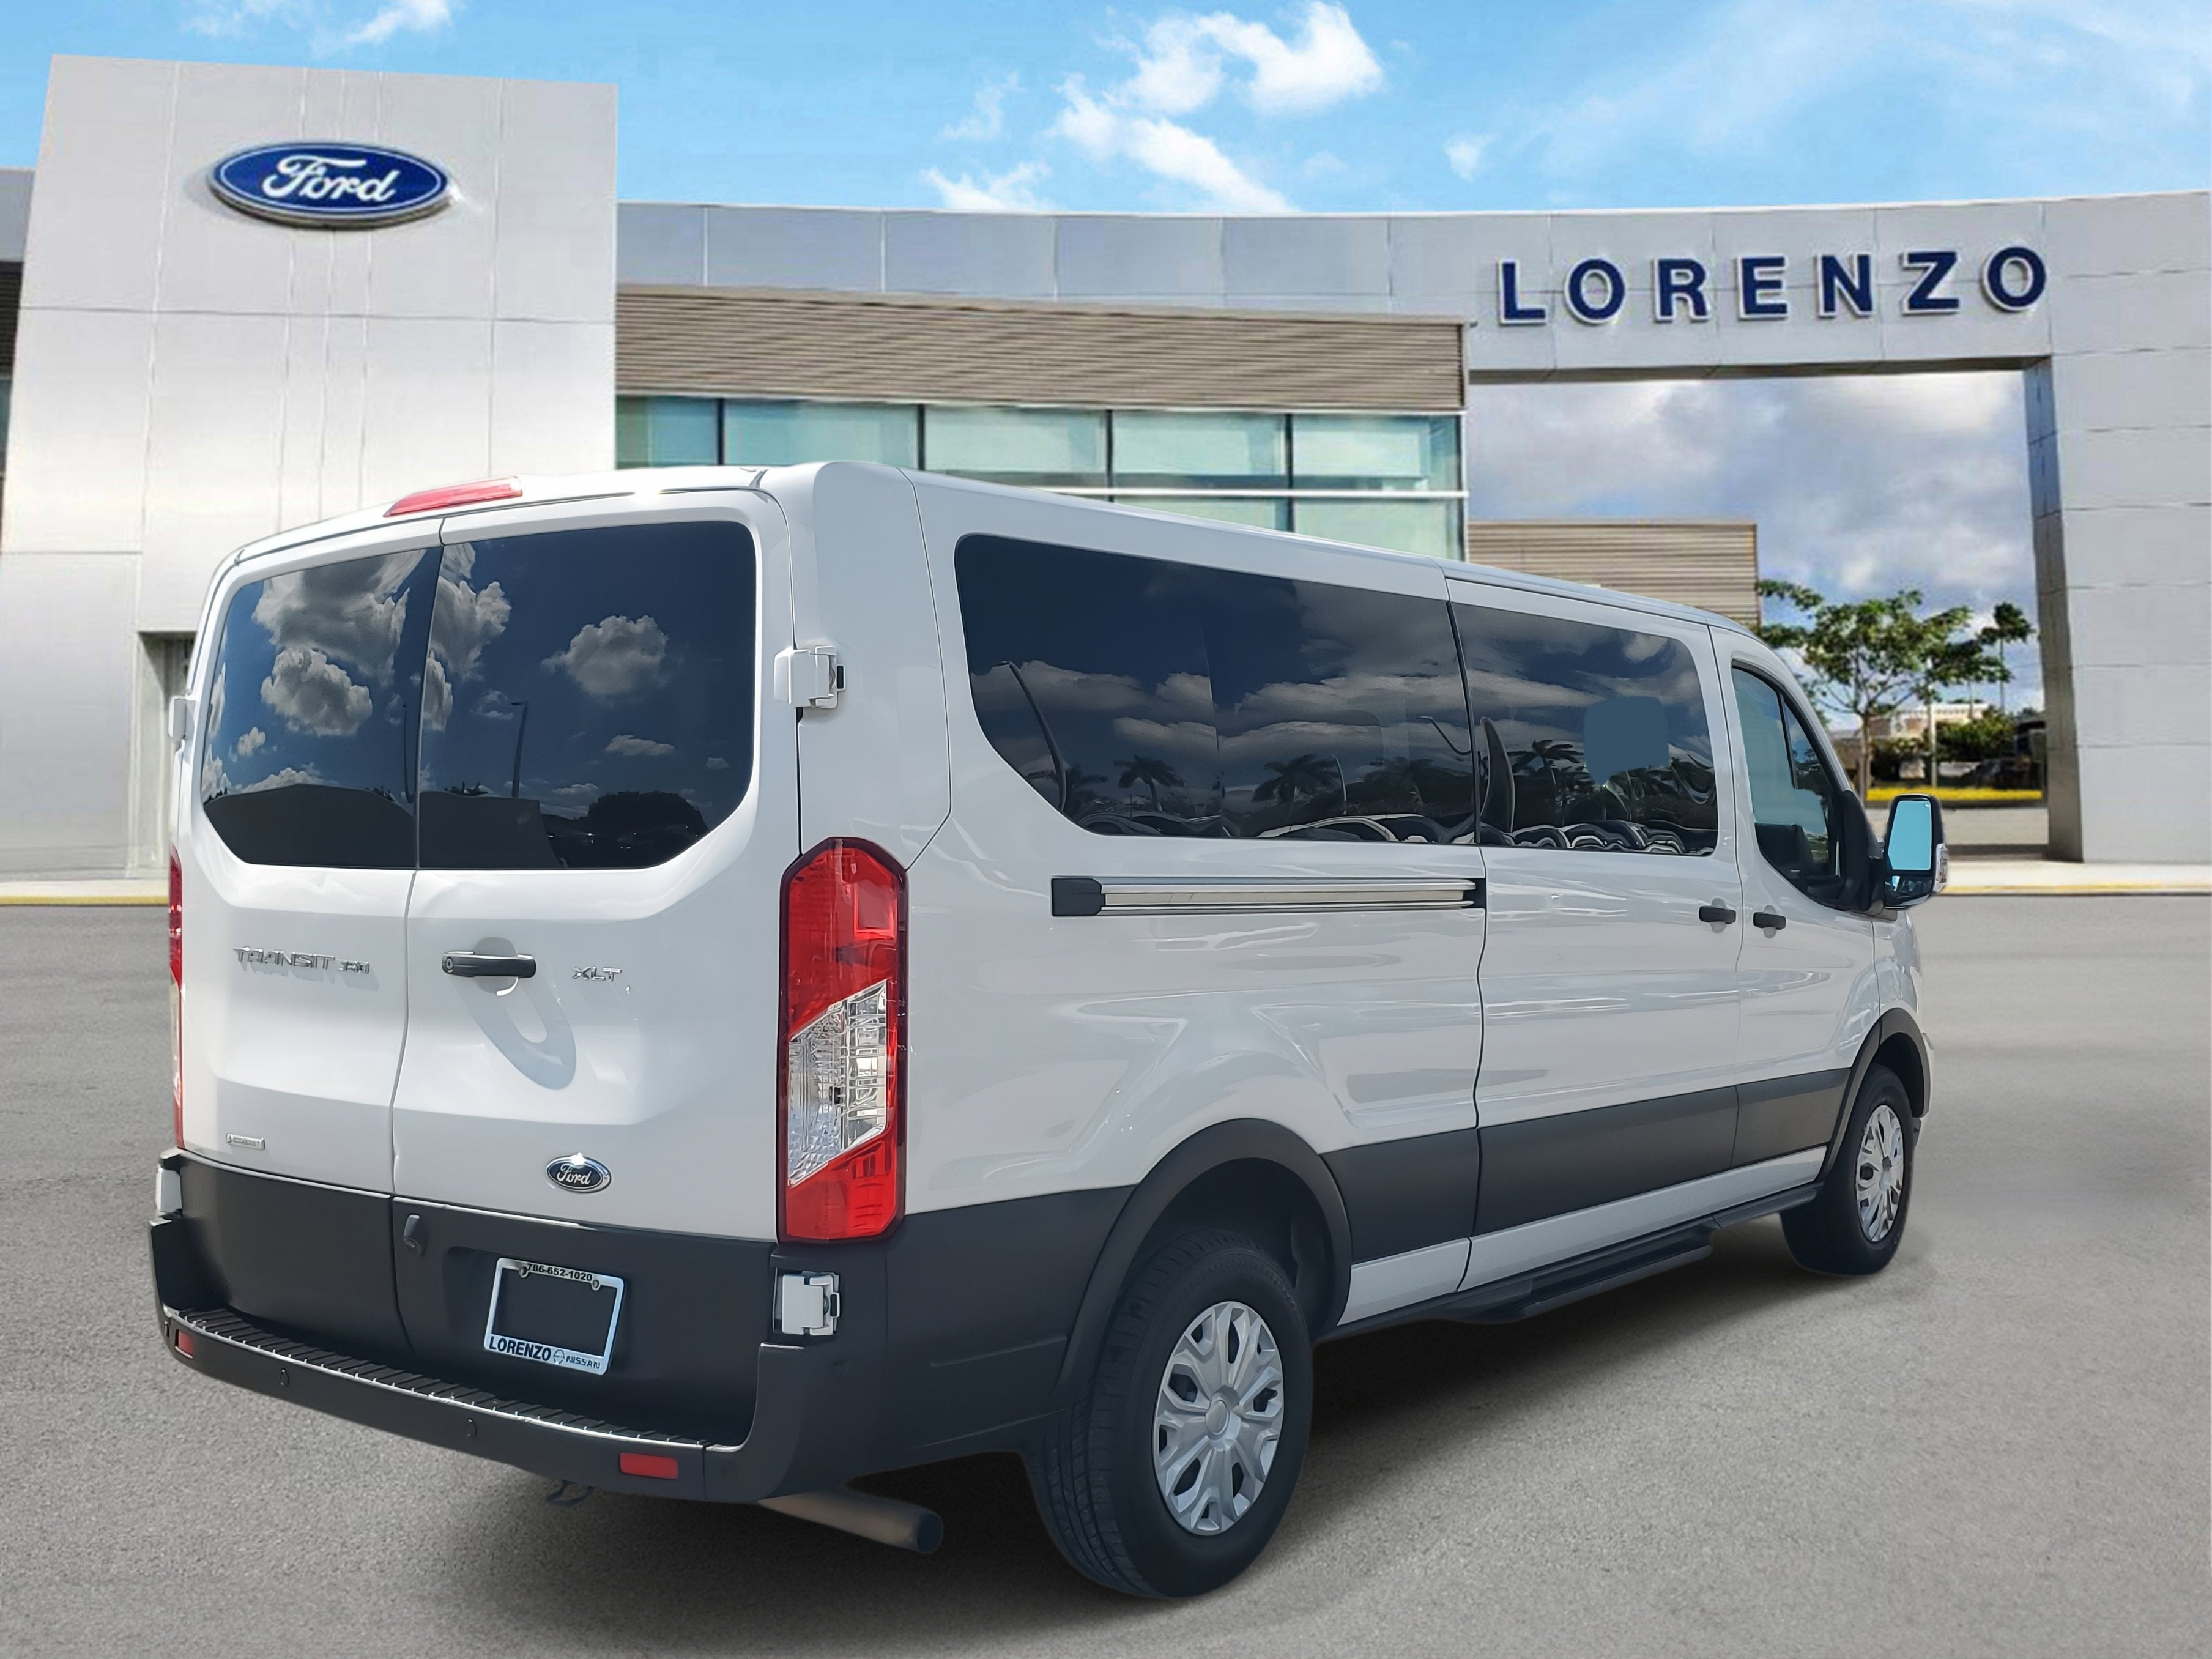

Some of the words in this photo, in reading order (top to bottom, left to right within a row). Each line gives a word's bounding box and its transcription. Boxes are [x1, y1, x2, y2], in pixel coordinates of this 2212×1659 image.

[262, 155, 400, 201] Ford
[1497, 245, 2047, 325] LORENZO
[232, 946, 335, 970] TRANSIT
[572, 965, 622, 982] XLT
[557, 1163, 592, 1184] Ford
[527, 1263, 593, 1281] 786-652-1020
[489, 1336, 552, 1361] LORENZO
[566, 1354, 601, 1370] NISSAN
